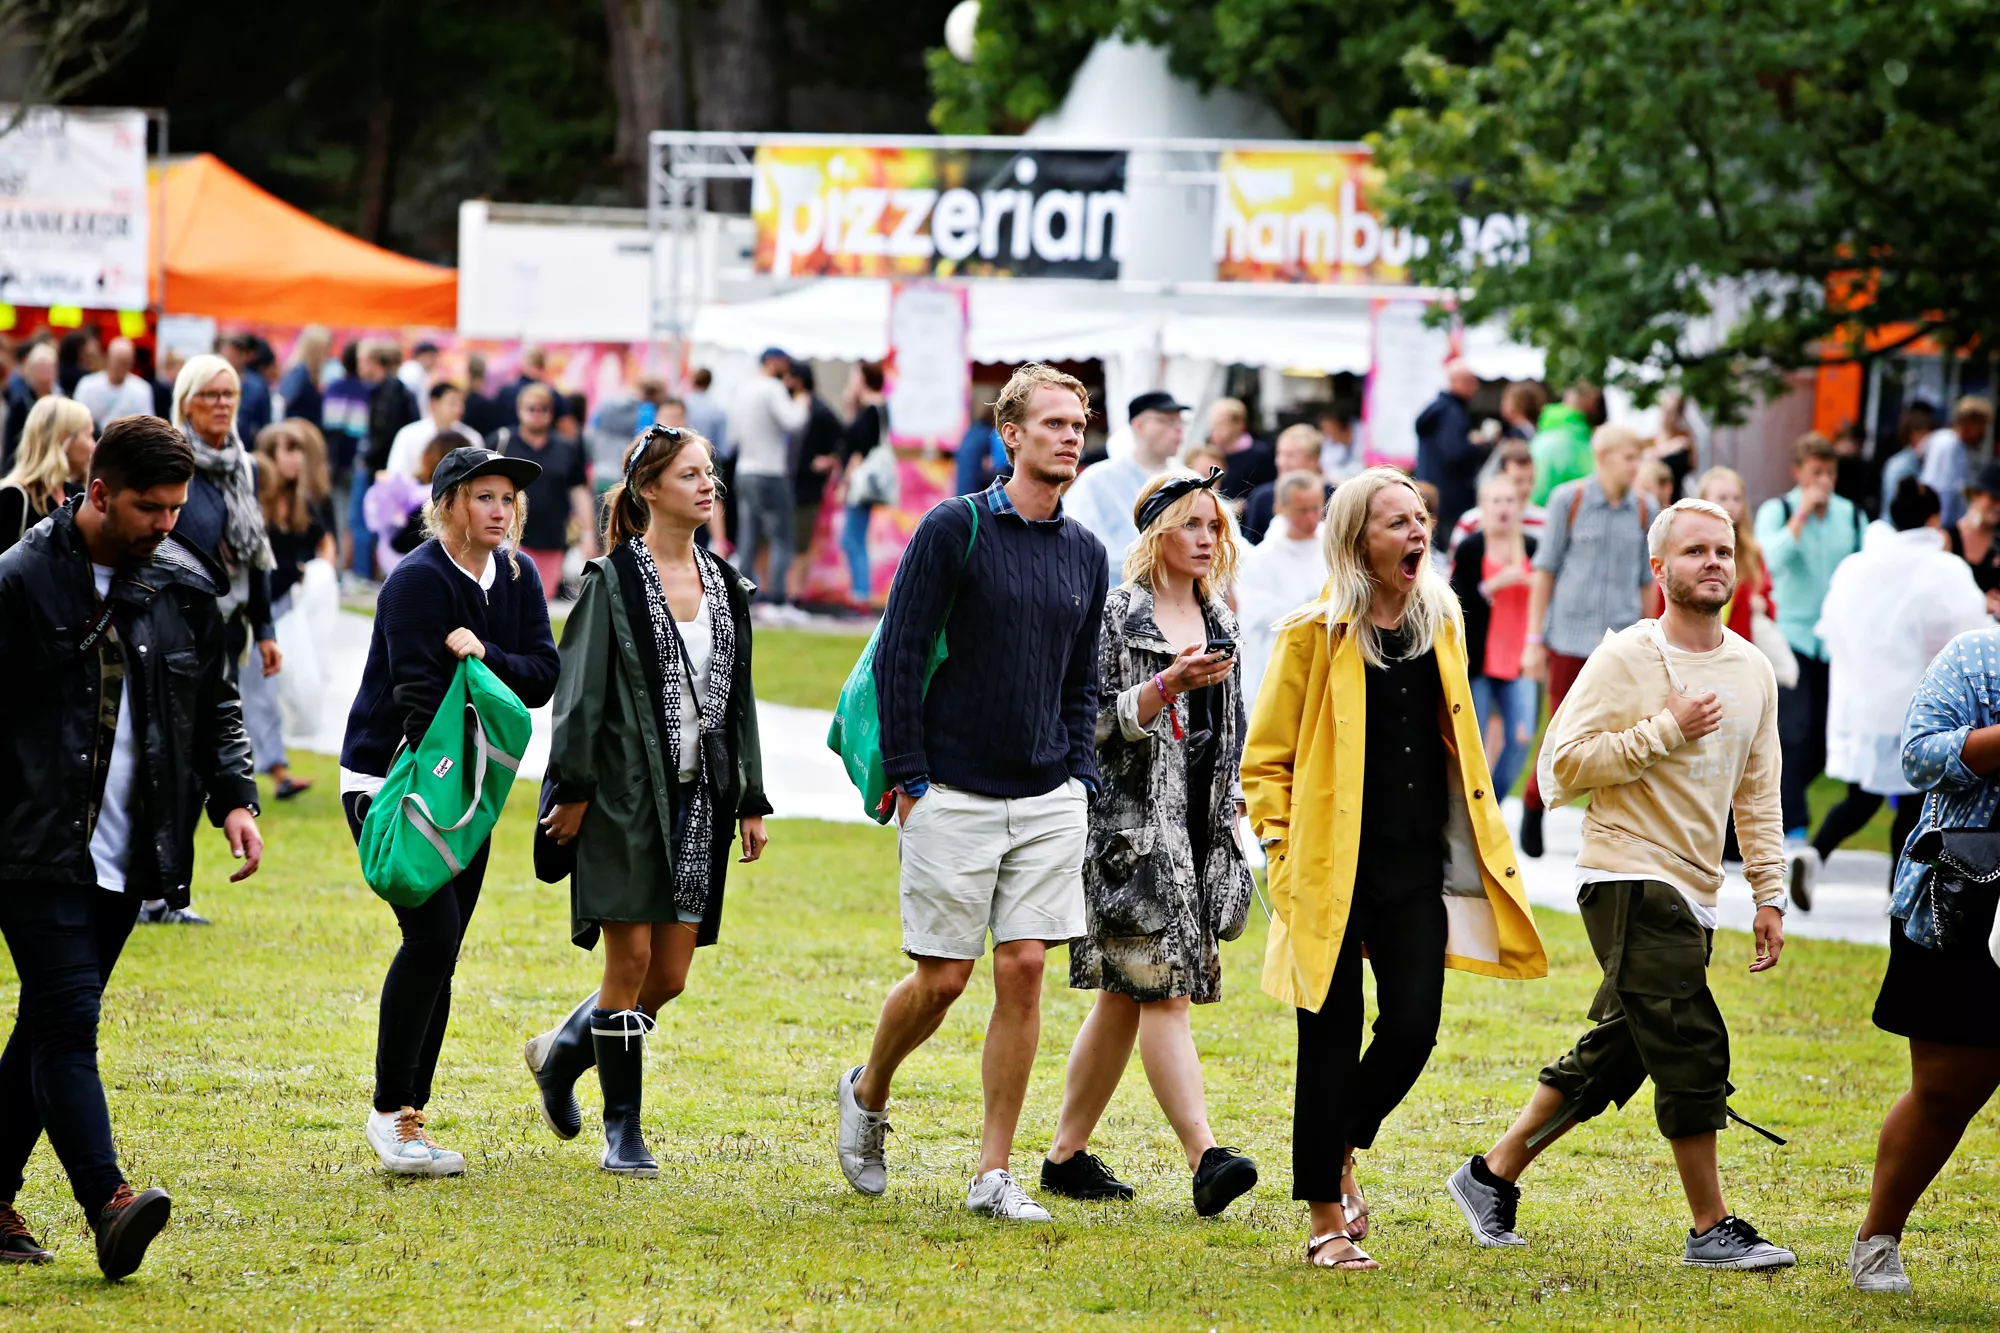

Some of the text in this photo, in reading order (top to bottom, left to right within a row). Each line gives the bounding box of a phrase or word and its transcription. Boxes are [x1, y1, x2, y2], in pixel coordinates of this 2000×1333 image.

[771, 154, 1127, 278] pizzerian
[1211, 178, 1531, 276] hambuer
[80, 604, 116, 651] EOS DIGIT
